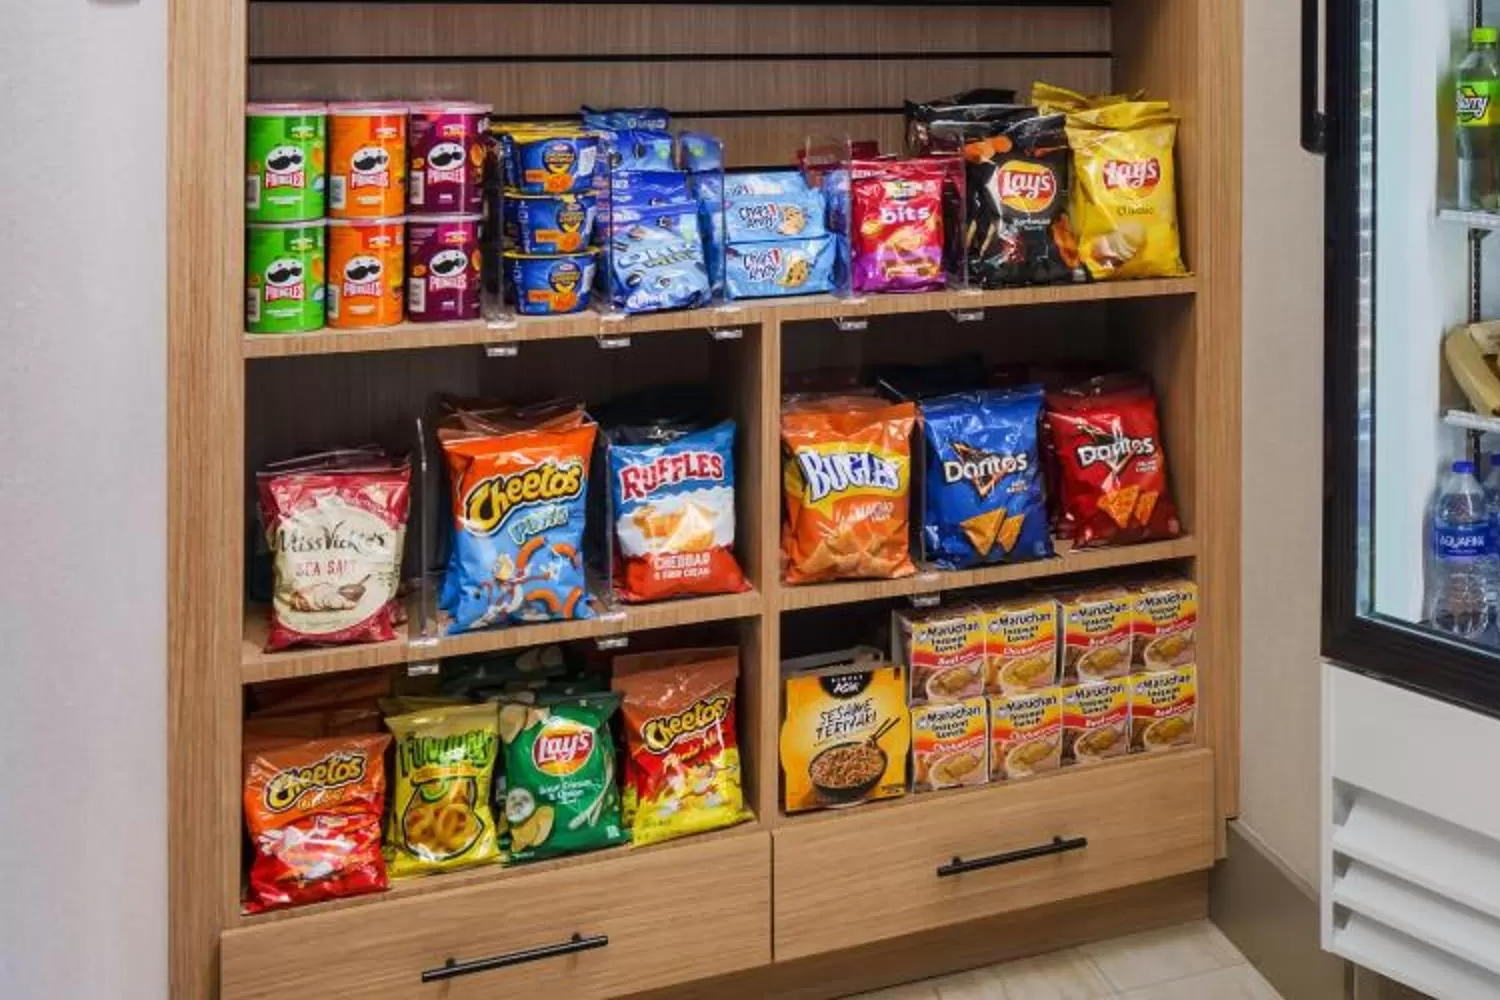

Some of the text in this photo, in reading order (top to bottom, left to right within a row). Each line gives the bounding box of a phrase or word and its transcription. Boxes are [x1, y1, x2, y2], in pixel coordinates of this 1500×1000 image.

[879, 203, 931, 225] bits
[942, 452, 1029, 484] Doritos
[1077, 435, 1155, 468] Doritos
[620, 451, 725, 503] RUFFLES
[798, 449, 900, 503] BUGLES
[466, 461, 583, 534] Cheetos
[999, 611, 1052, 626] Maruchan
[642, 696, 730, 752] Cheetos
[927, 706, 981, 722] Maruchan
[266, 751, 367, 812] Cheetos
